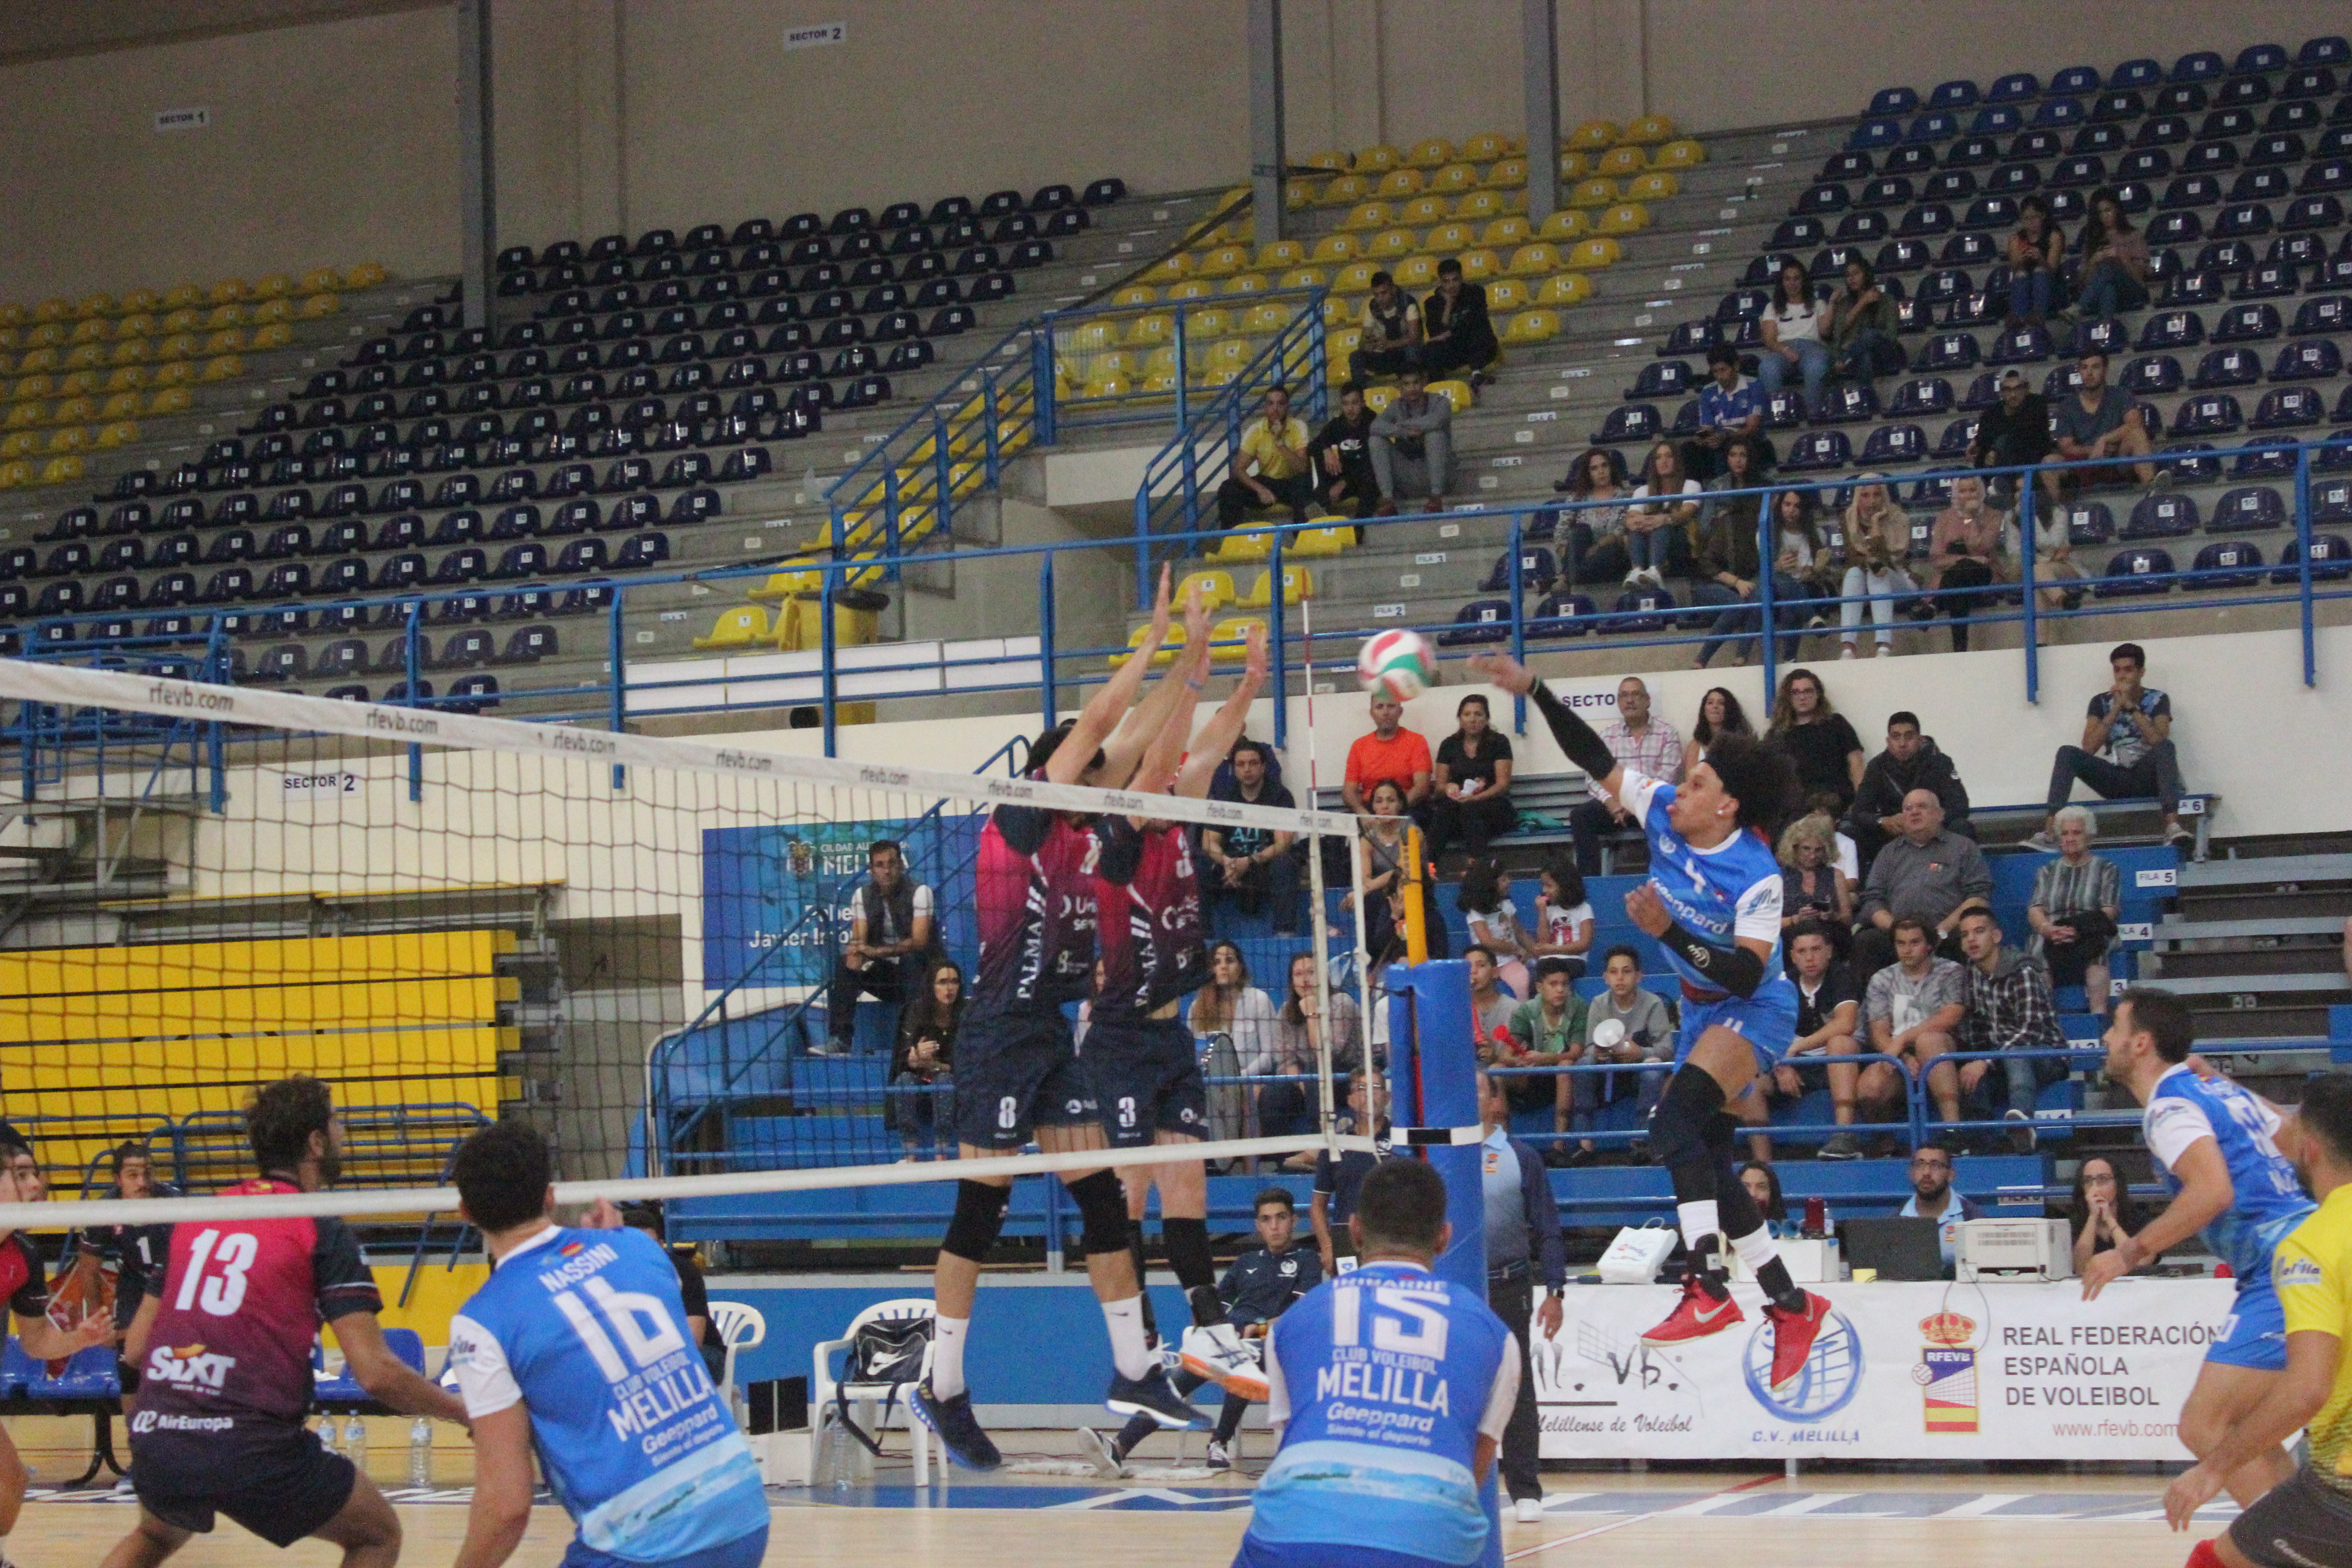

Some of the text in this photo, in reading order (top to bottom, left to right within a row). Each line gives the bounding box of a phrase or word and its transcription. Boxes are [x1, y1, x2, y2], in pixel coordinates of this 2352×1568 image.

[790, 28, 841, 41] SECTOR 2
[1396, 606, 1402, 615] 2
[150, 681, 234, 710] rfevb.com
[1562, 694, 1616, 707] SECTO
[367, 708, 438, 735] rfevb.com
[554, 730, 616, 754] rfevb.com
[716, 749, 772, 770] rfevb.com
[284, 775, 355, 792] SECTOR 2
[2193, 801, 2201, 811] 6
[2165, 872, 2173, 882] 5
[2141, 927, 2149, 937] 4
[998, 1096, 1017, 1129] 8
[1118, 1097, 1136, 1128] 3
[175, 1228, 259, 1318] 13
[553, 1274, 687, 1384] 16
[1333, 1285, 1451, 1361] 15
[2003, 1321, 2220, 1345] REAL FEDERACIÓN
[1926, 1352, 1970, 1362] RFEVB
[2004, 1353, 2129, 1375] ESPAÑOLA
[1316, 1361, 1449, 1417] MELILLA
[2006, 1387, 2160, 1406] DE VOLEIBOL
[607, 1362, 716, 1442] MELILLA
[1326, 1401, 1435, 1433] Geeppard
[1610, 1416, 1627, 1432] de
[1634, 1413, 1693, 1432] Voleibol
[1787, 1428, 1859, 1446] MELILLA
[2053, 1419, 2179, 1437] www.rfevb.com
